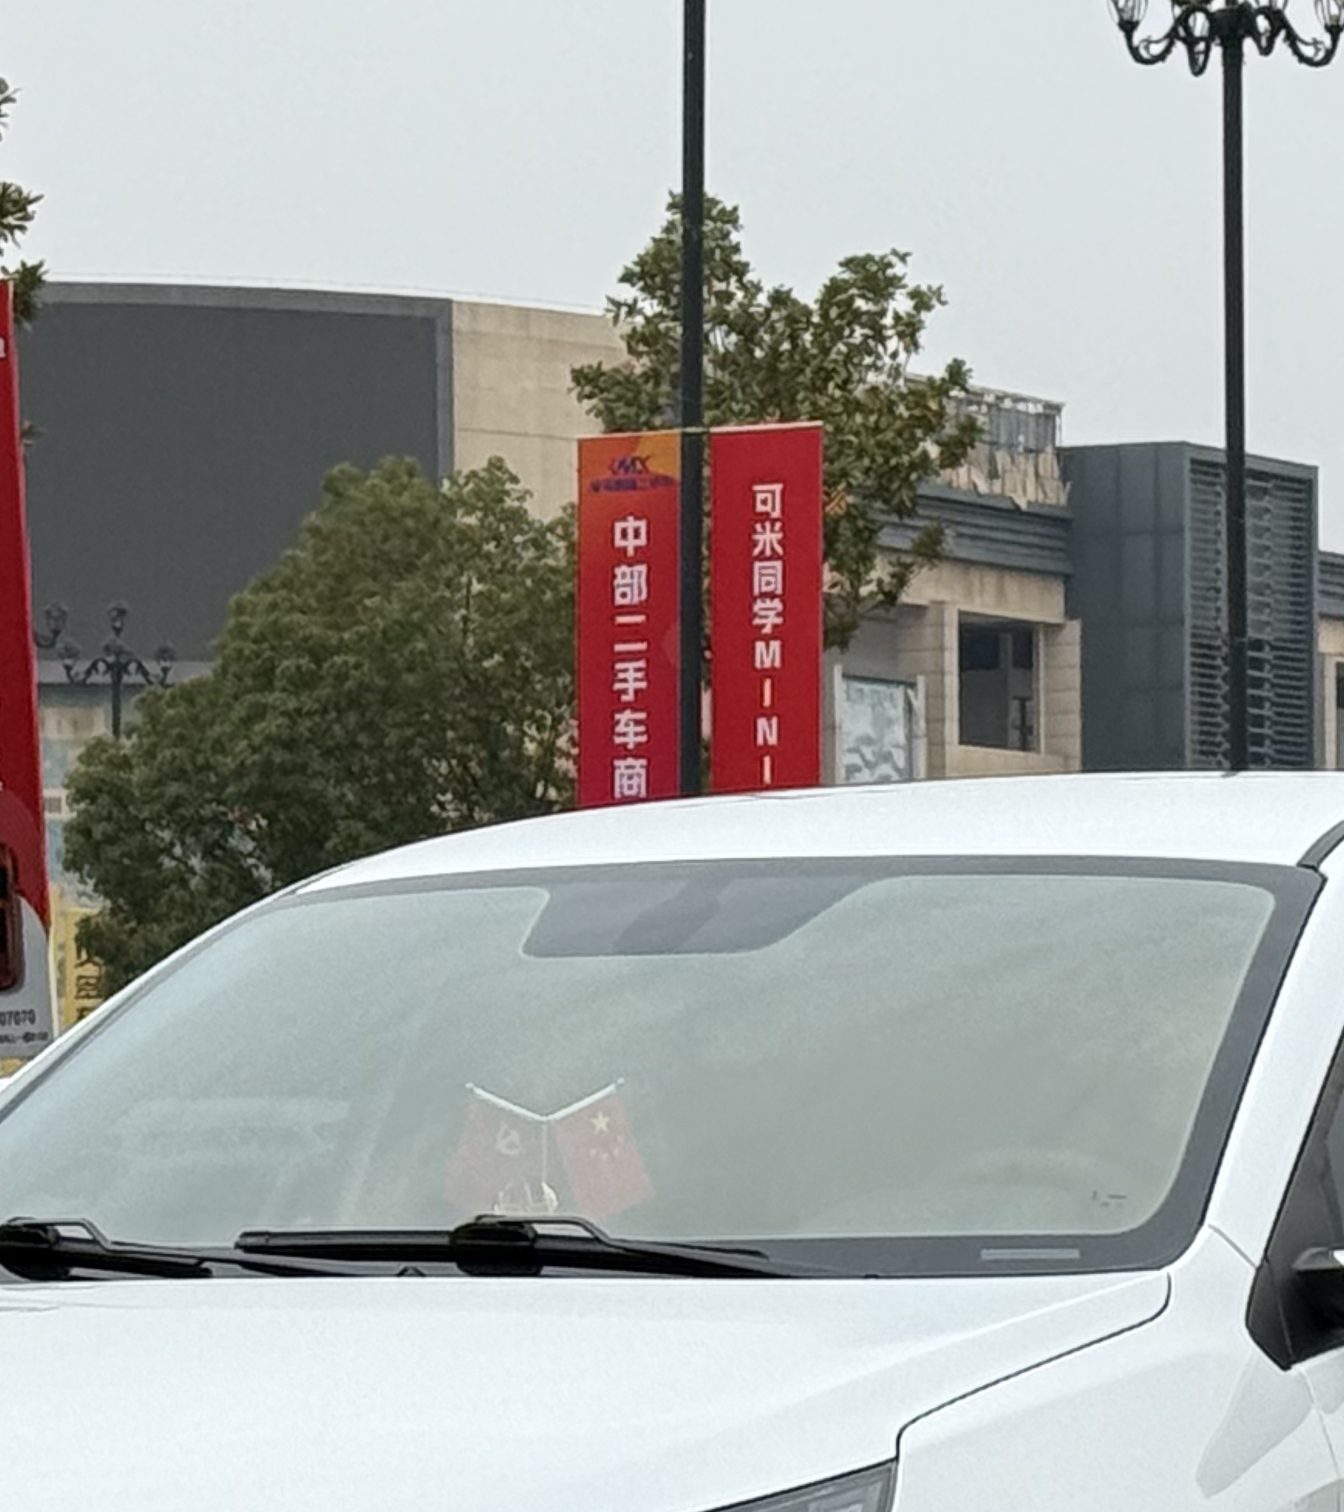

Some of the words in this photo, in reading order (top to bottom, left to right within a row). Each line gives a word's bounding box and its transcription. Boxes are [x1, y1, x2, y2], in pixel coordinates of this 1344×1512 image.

[613, 515, 648, 799] 中部二手车商
[751, 482, 784, 784] 可米同学MINI
